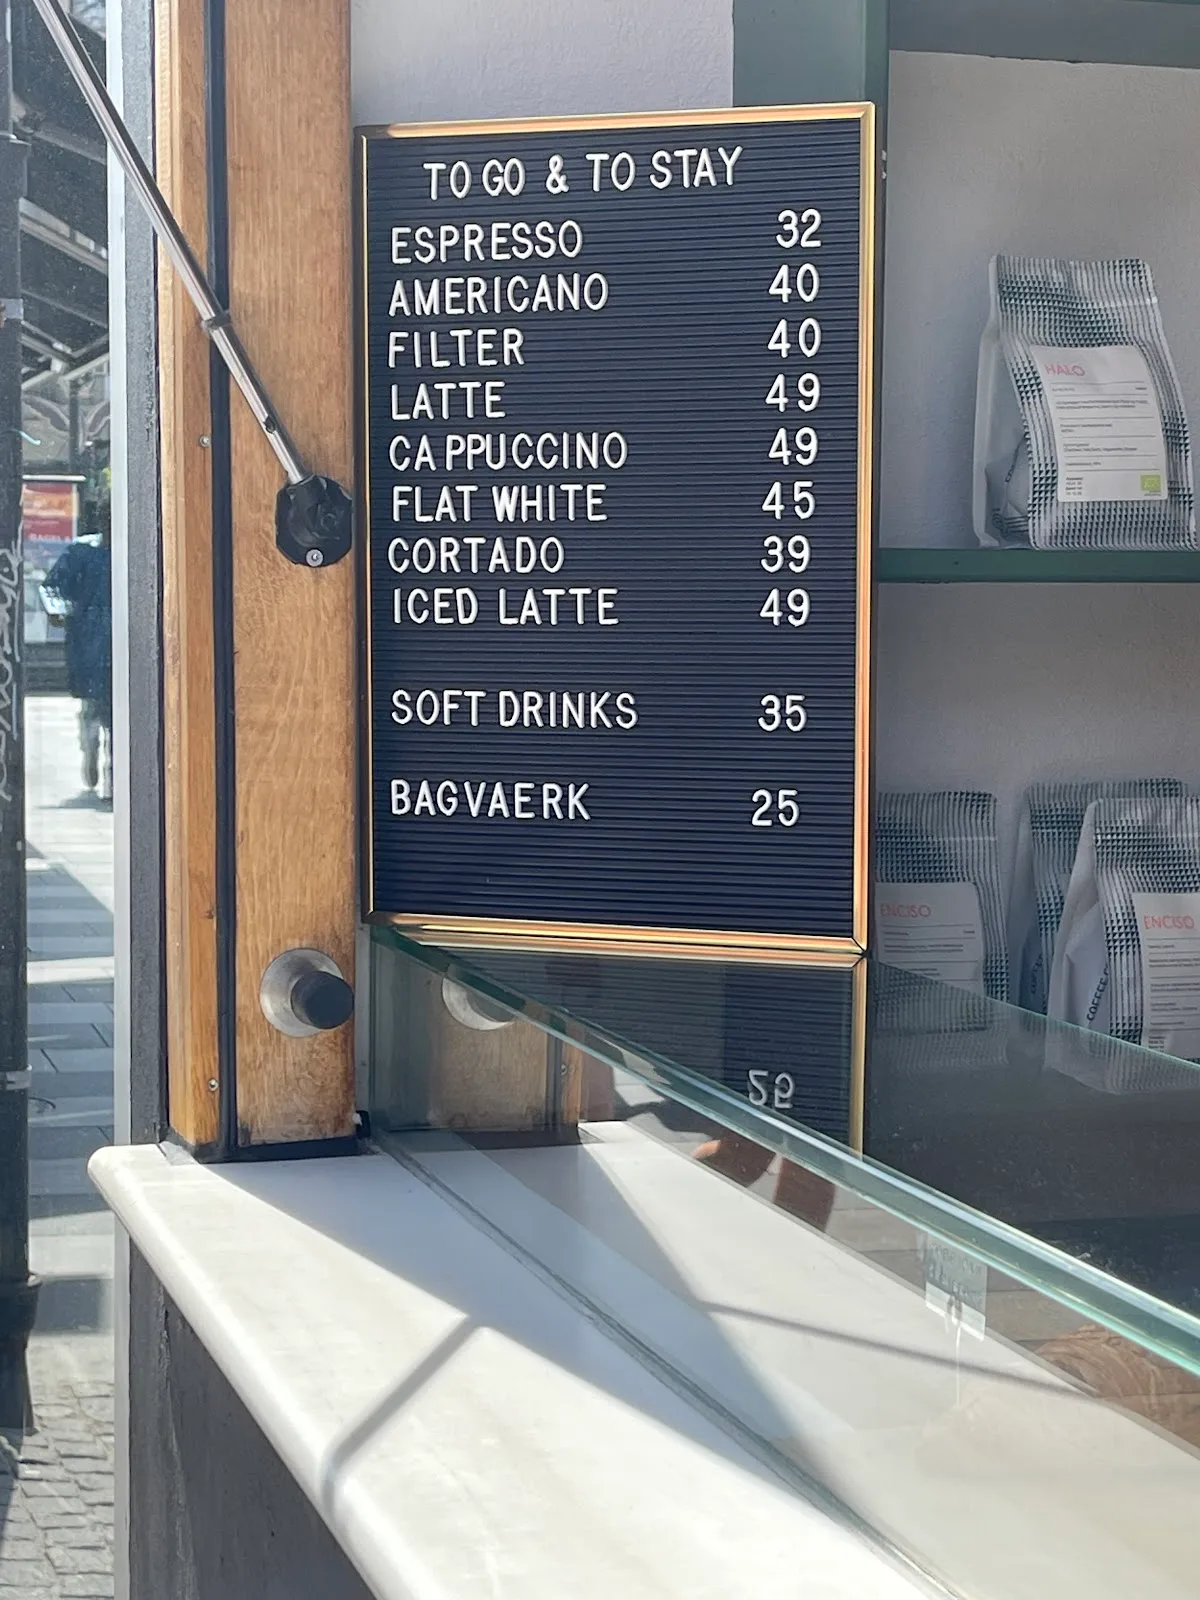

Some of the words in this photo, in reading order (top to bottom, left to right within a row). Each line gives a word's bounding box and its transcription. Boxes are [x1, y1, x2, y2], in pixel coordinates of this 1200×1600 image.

[423, 160, 472, 201] TO
[482, 157, 525, 197] GO
[545, 154, 570, 195] &
[585, 151, 636, 192] TO
[649, 145, 743, 190] STAY
[391, 219, 583, 265] ESPRESSO
[775, 208, 822, 249] 32
[388, 272, 609, 317] AMERICANO
[768, 263, 820, 303] 40
[388, 328, 525, 368] FILTER
[767, 317, 821, 358] 40
[1044, 364, 1085, 376] HALO
[391, 381, 506, 421] LATTE
[765, 372, 820, 413] 49
[389, 431, 627, 472] CAPPUCCINO
[768, 426, 818, 466] 49
[393, 485, 478, 523] FLAT
[491, 484, 608, 523] WHITE
[761, 480, 815, 520] 45
[388, 536, 564, 574] CORTADO
[760, 534, 810, 573] 39
[394, 587, 478, 625] ICED
[499, 587, 619, 626] LATTE
[759, 588, 810, 627] 49
[391, 689, 487, 727] SOFT
[499, 690, 637, 729] DRINKS
[758, 694, 806, 732] 35
[391, 779, 590, 820] BAGVAERK
[751, 789, 799, 827] 25
[1144, 915, 1195, 930] ENCISO
